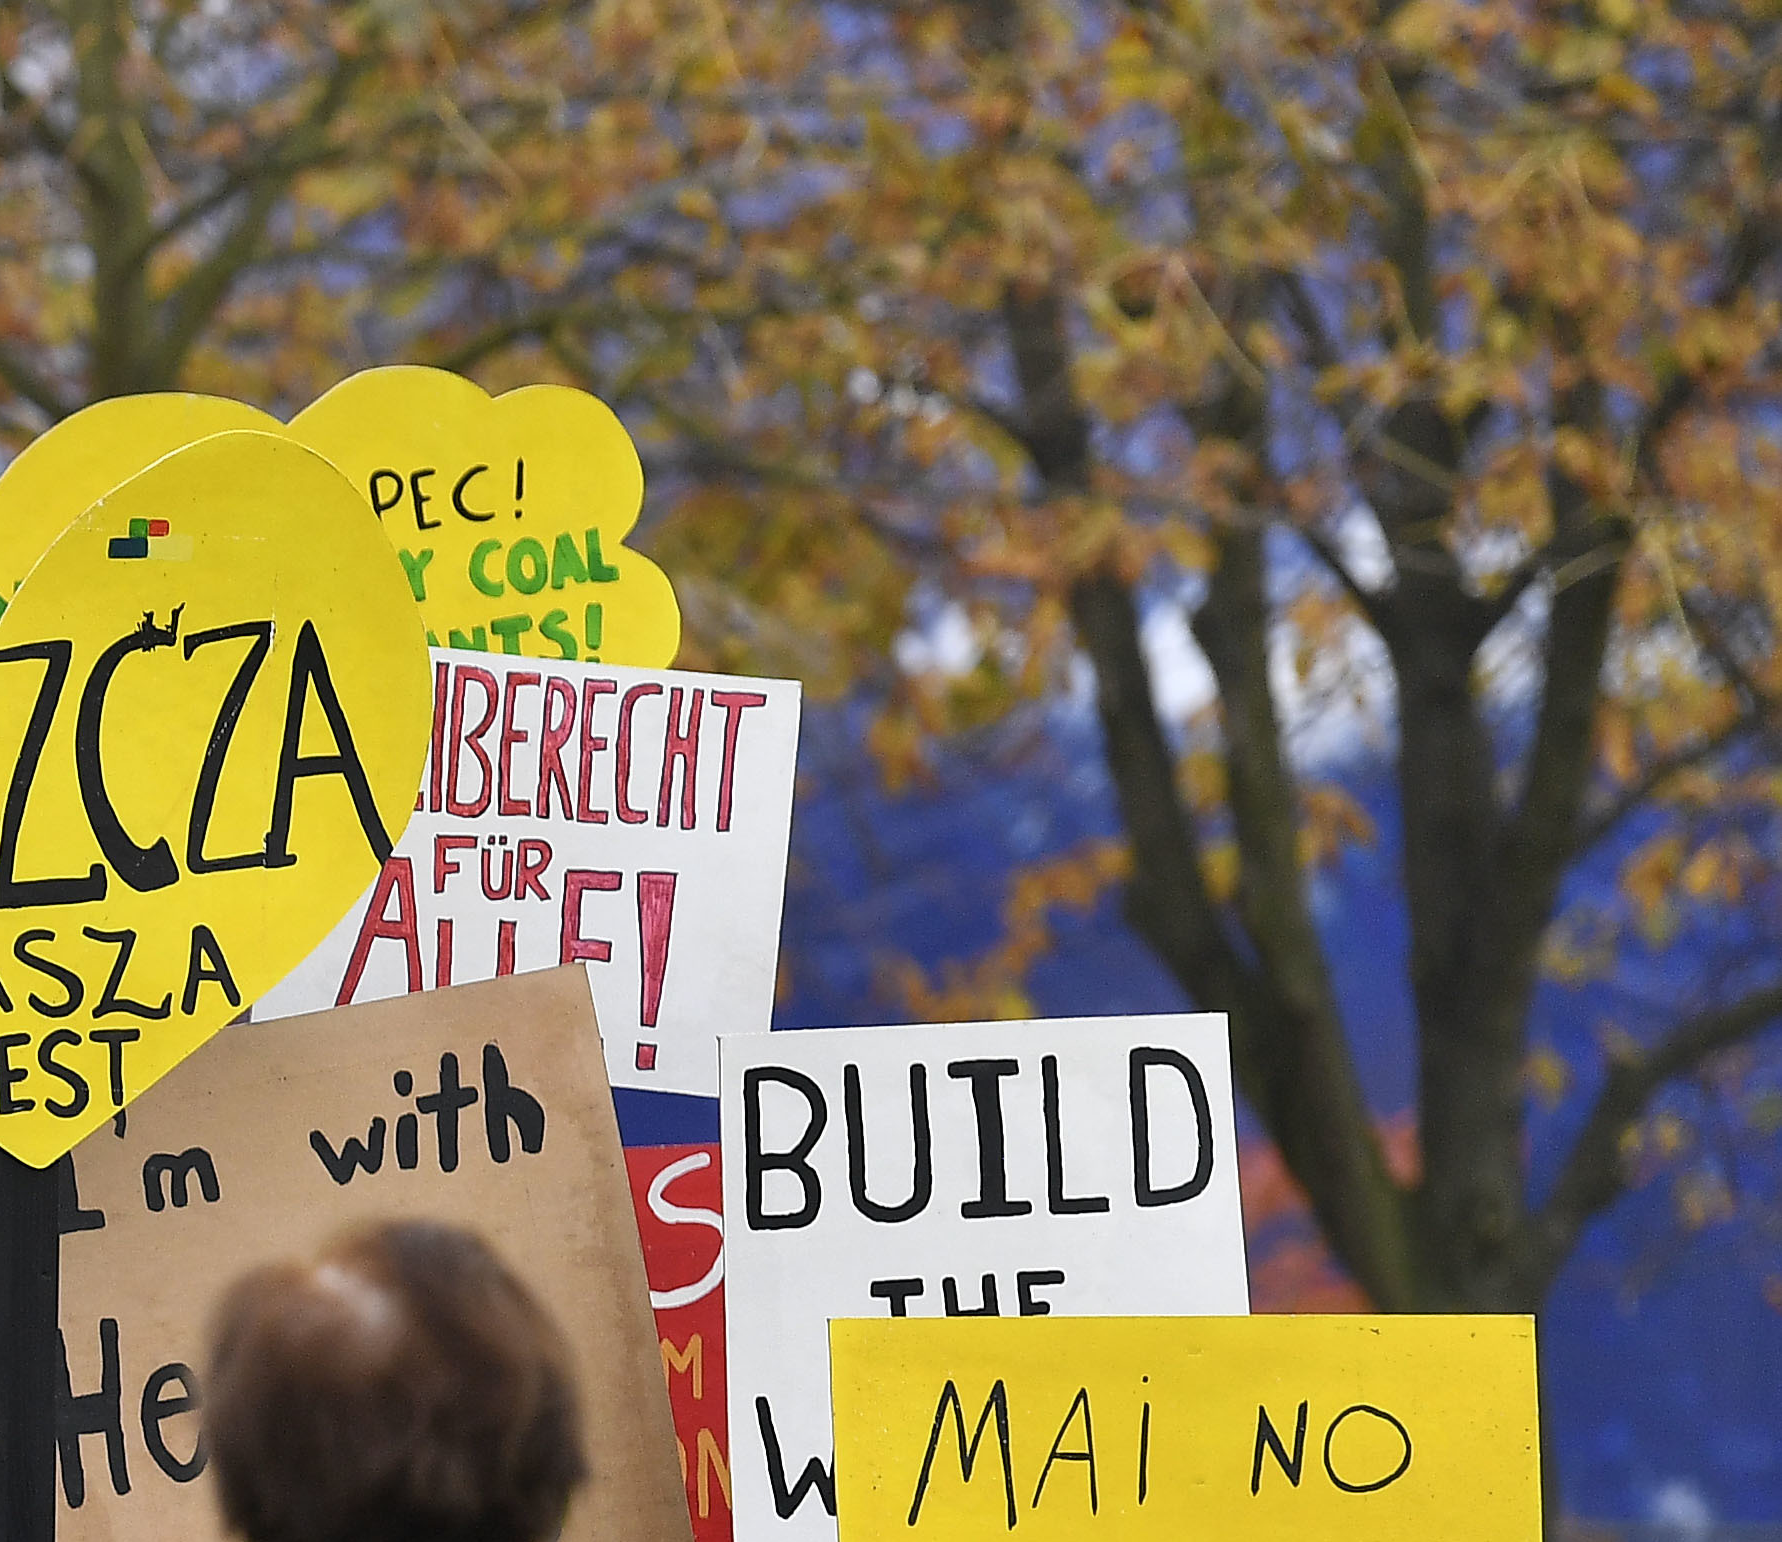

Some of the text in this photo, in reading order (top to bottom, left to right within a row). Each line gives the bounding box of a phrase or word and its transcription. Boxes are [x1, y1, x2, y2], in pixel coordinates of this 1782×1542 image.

[468, 527, 621, 598] COAL
[415, 661, 767, 832] IBERECHT
[434, 834, 553, 902] FÜR
[310, 1042, 546, 1187] with
[743, 1046, 1214, 1231] BUILD
[1251, 1400, 1412, 1496] NO
